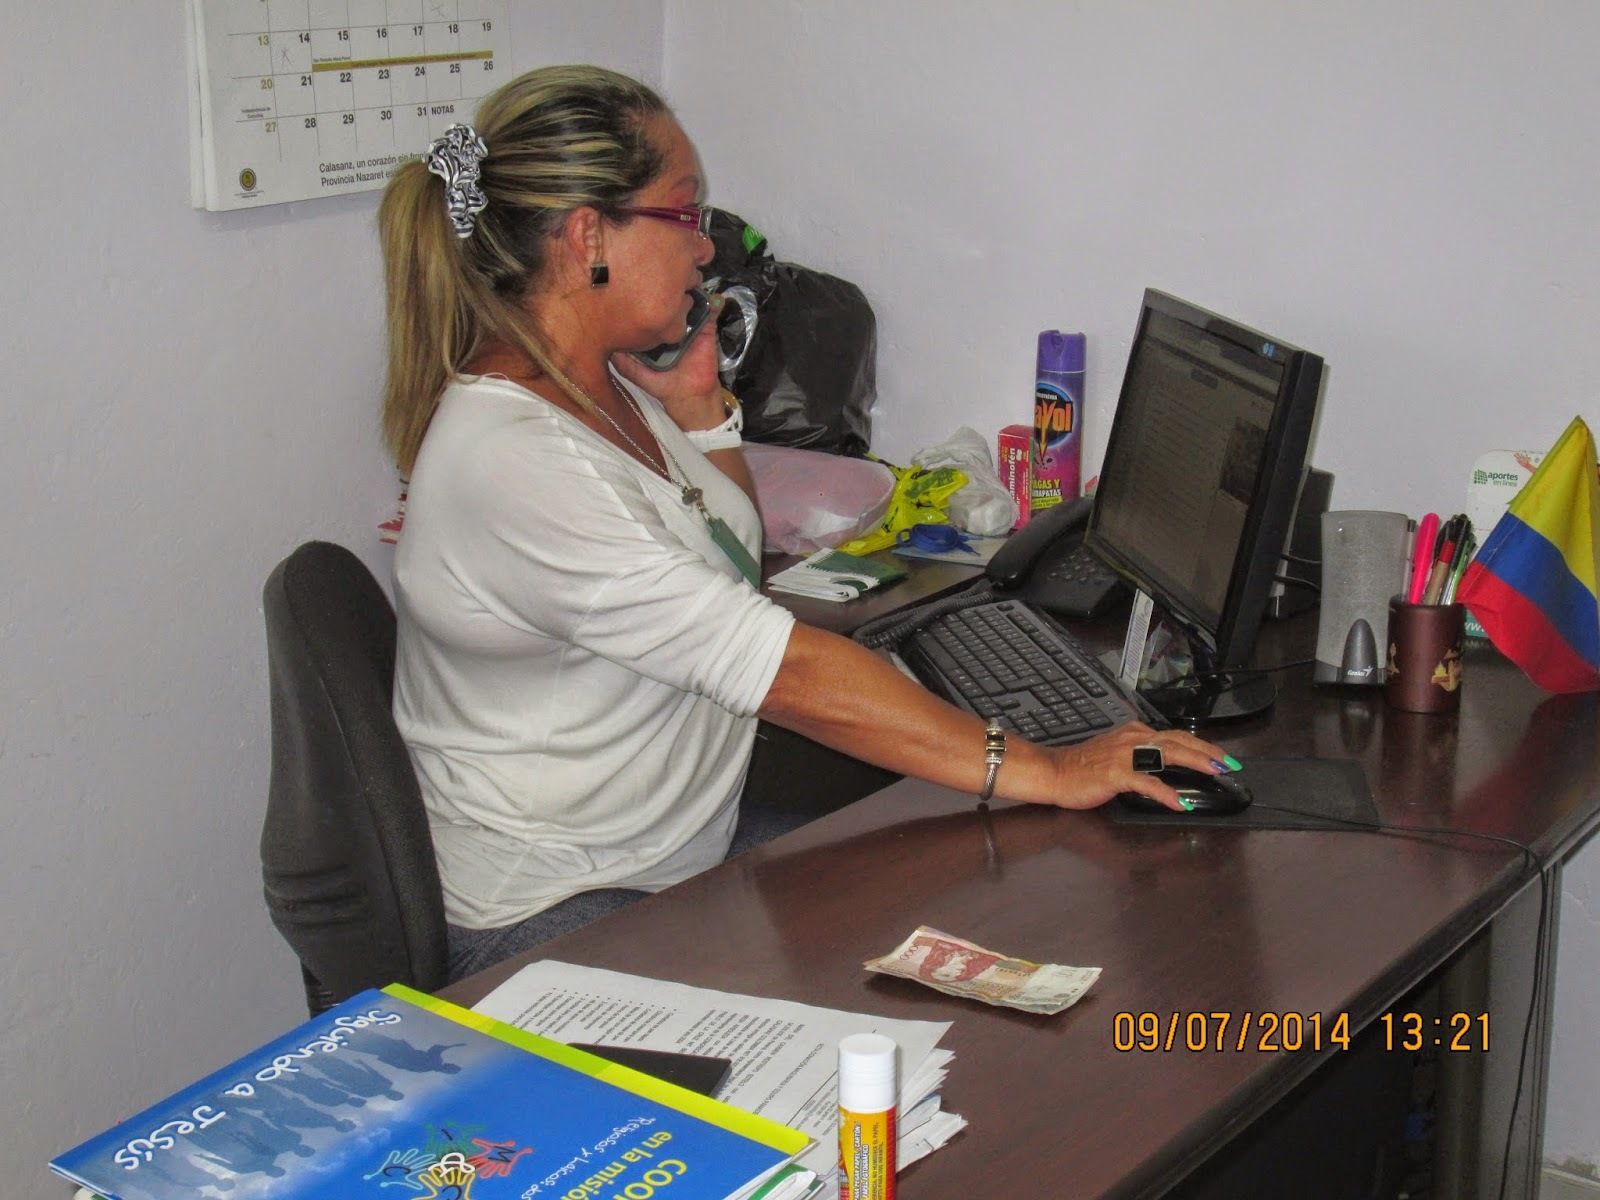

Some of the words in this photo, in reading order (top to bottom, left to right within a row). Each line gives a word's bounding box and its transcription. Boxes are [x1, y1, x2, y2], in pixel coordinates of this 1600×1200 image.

[258, 35, 270, 46] 13
[299, 33, 310, 44] 14
[337, 30, 349, 41] 15
[376, 28, 387, 38] 16
[412, 26, 423, 36] 17
[448, 23, 459, 34] 18
[482, 22, 492, 32] 19
[260, 79, 273, 90] 20
[301, 75, 312, 87] 21
[340, 72, 352, 83] 22
[378, 69, 390, 80] 23
[415, 66, 426, 77] 24
[450, 63, 461, 74] 25
[483, 61, 494, 71] 26
[265, 121, 277, 133] 27
[304, 118, 317, 129] 28
[343, 114, 355, 124] 29
[380, 110, 392, 120] 30
[417, 107, 427, 117] 31
[431, 105, 455, 116] NOTAS
[319, 161, 355, 173] Calasanz,
[356, 160, 366, 169] un
[367, 155, 397, 167] corazón
[321, 175, 355, 187] Provincia
[356, 170, 385, 182] Nazaret
[1488, 472, 1518, 481] aportes
[256, 1008, 402, 1083] Siguiendo
[225, 1083, 255, 1098] a
[113, 1104, 227, 1171] Jesús
[642, 1131, 672, 1149] en
[621, 1148, 654, 1163] la
